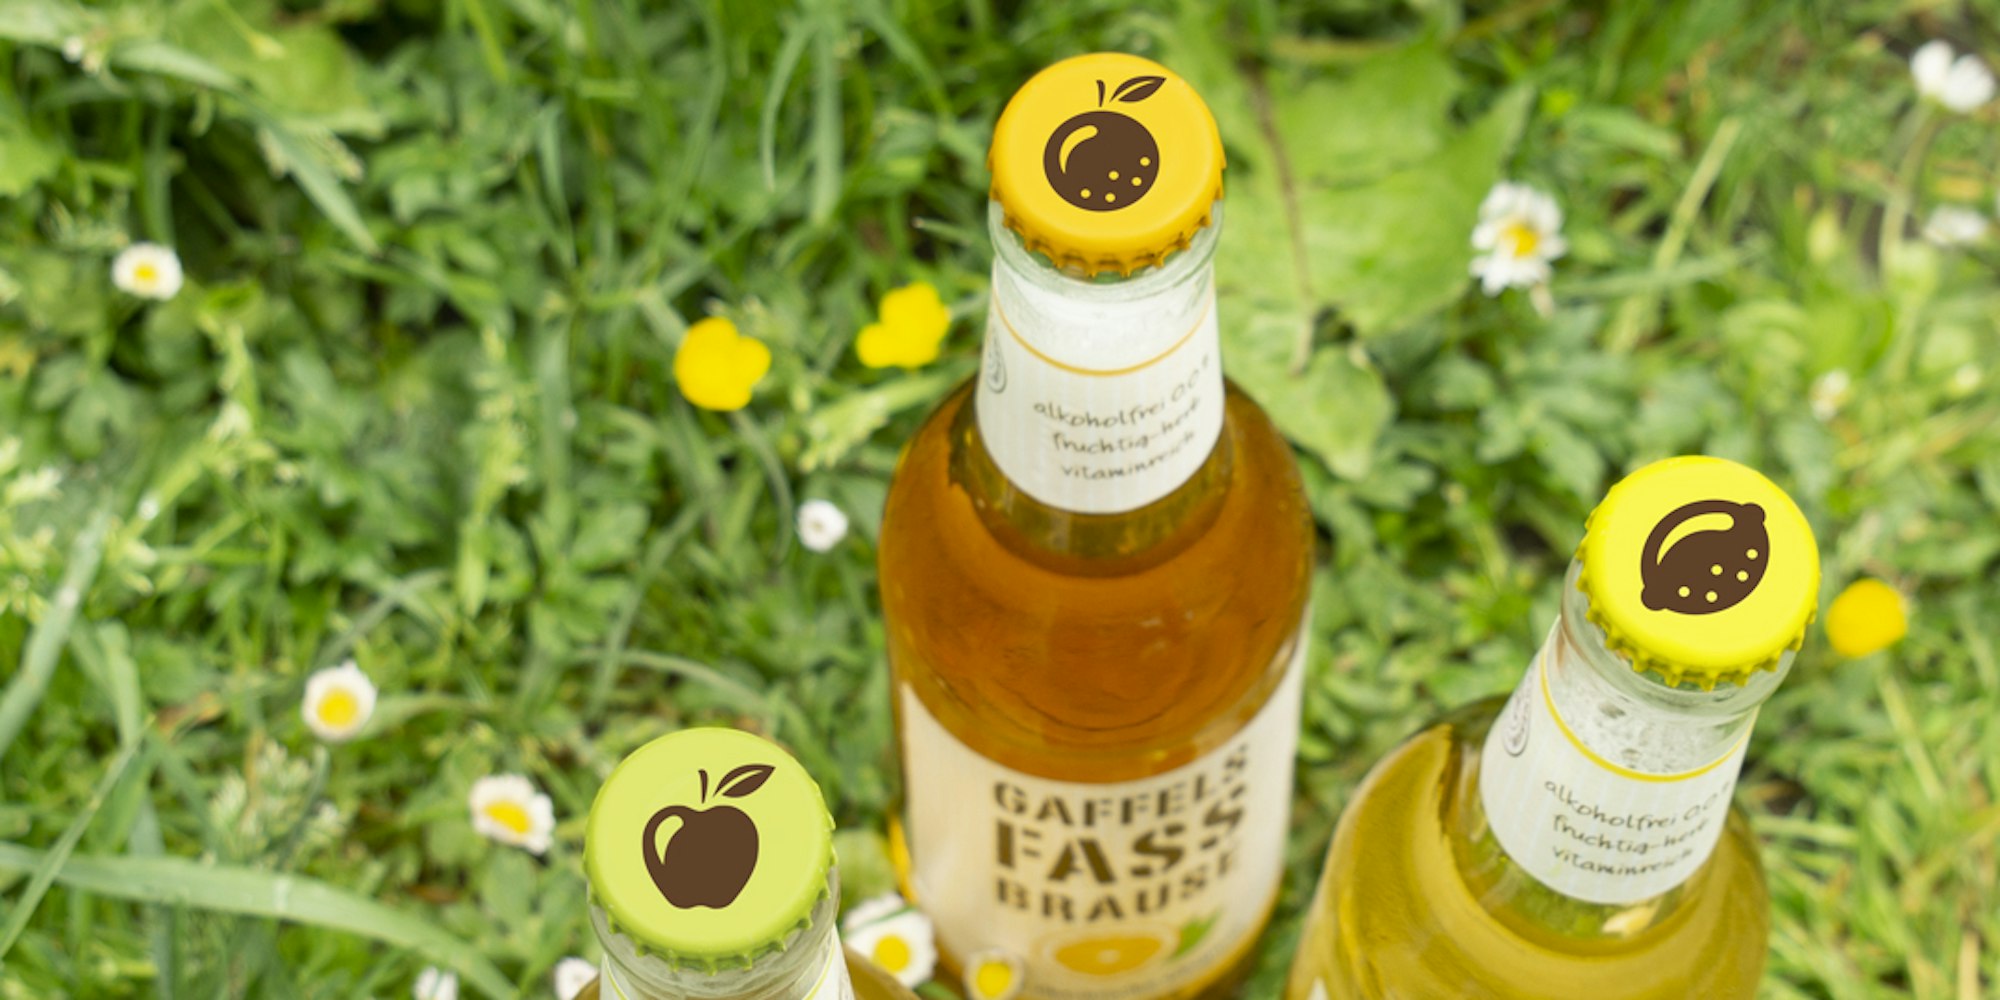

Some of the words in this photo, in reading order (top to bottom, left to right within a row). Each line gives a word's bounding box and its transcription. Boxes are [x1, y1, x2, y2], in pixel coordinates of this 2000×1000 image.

[1033, 399, 1165, 429] alkoholfrei
[1061, 430, 1196, 480] vitaminreich
[993, 743, 1250, 828] GAFFELS
[1544, 779, 1677, 831] alkoholfrei
[995, 785, 1247, 885] FASS
[996, 842, 1239, 923] BRAUSE
[1552, 846, 1695, 877] vitaminreich
